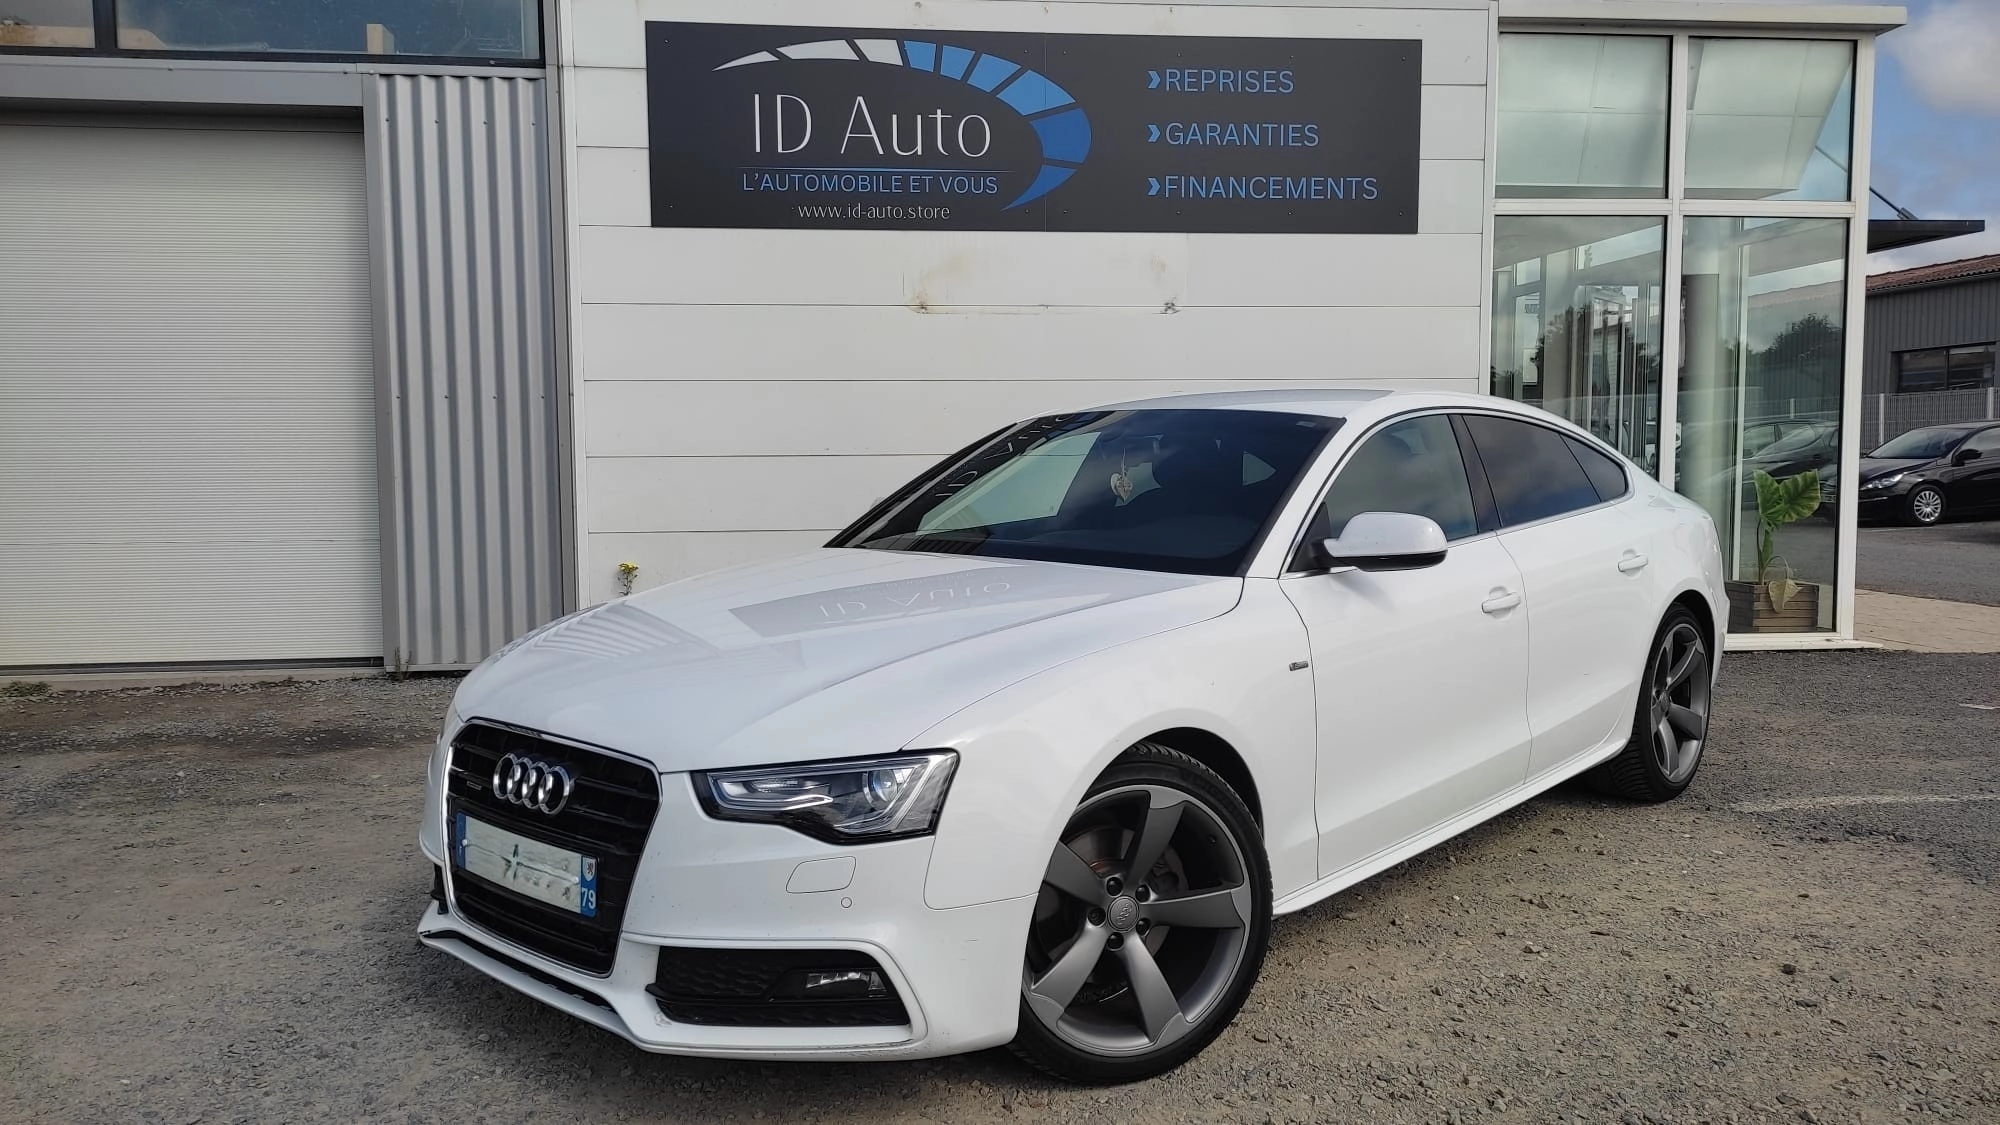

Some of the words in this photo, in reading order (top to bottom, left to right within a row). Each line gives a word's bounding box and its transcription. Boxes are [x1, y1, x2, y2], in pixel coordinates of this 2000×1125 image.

[1166, 69, 1294, 93] REPRISES
[754, 93, 812, 153] ID
[840, 95, 991, 157] Auto
[1165, 122, 1319, 147] GARANTIES
[909, 175, 934, 193] ET
[939, 176, 998, 194] VOUS
[1165, 175, 1378, 200] FINANCEMENTS
[799, 203, 950, 220] www.id-auto.store
[581, 887, 597, 910] 79
